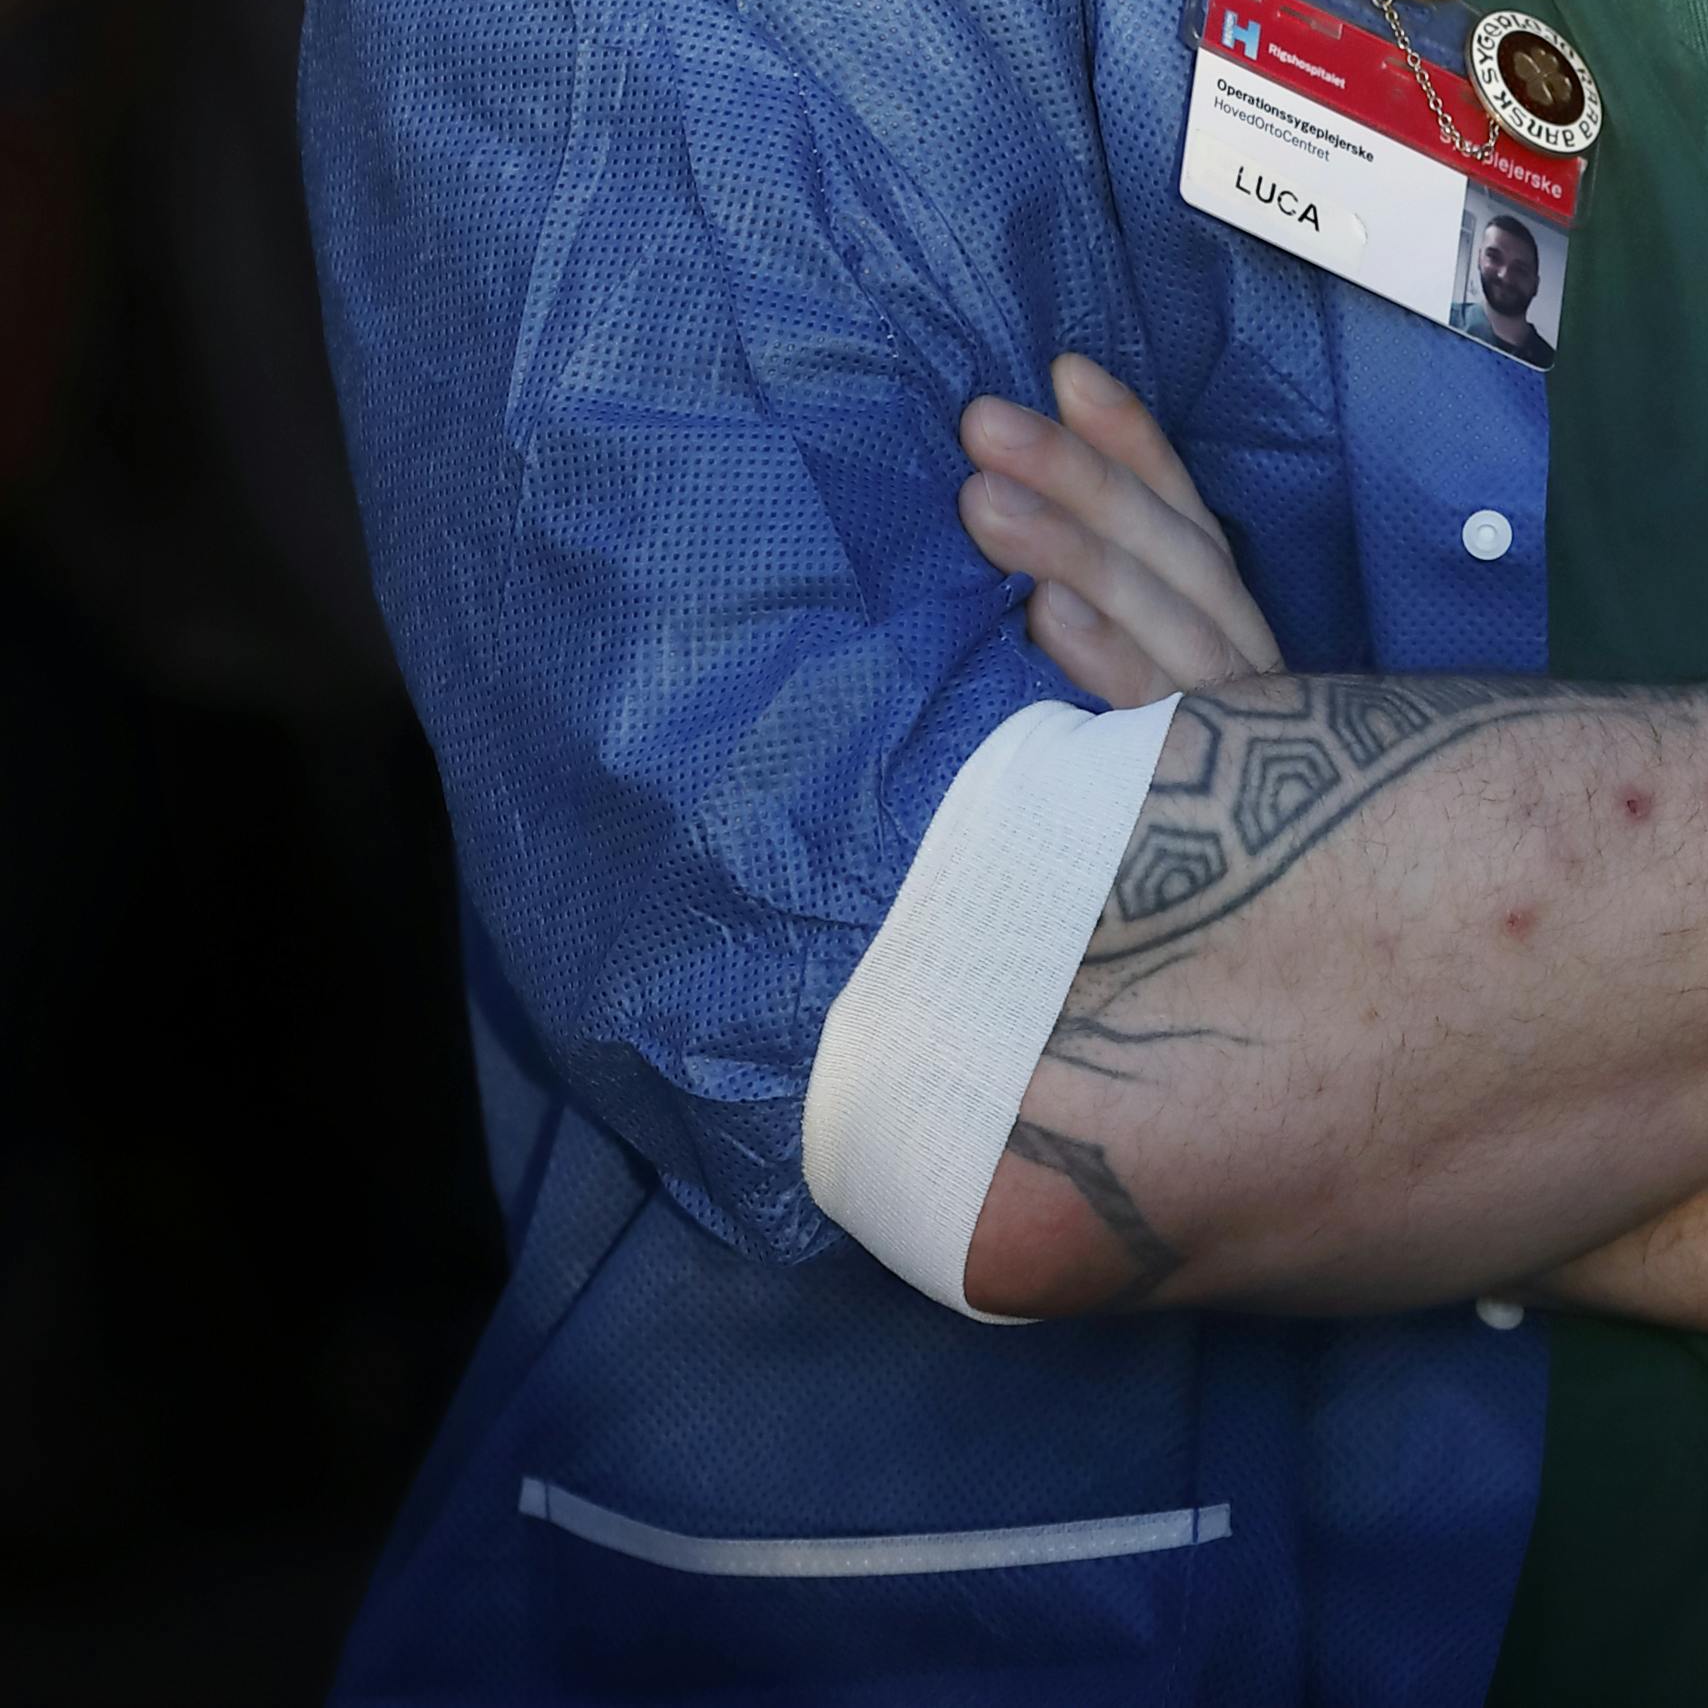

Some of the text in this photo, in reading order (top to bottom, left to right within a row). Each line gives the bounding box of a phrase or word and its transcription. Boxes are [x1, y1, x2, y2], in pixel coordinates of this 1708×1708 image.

[1268, 43, 1346, 89] Rigshospitalet
[1213, 97, 1331, 162] HovedOrtoCentret
[1217, 78, 1375, 163] Operationssygeplejerske
[1235, 166, 1321, 232] LUCA
